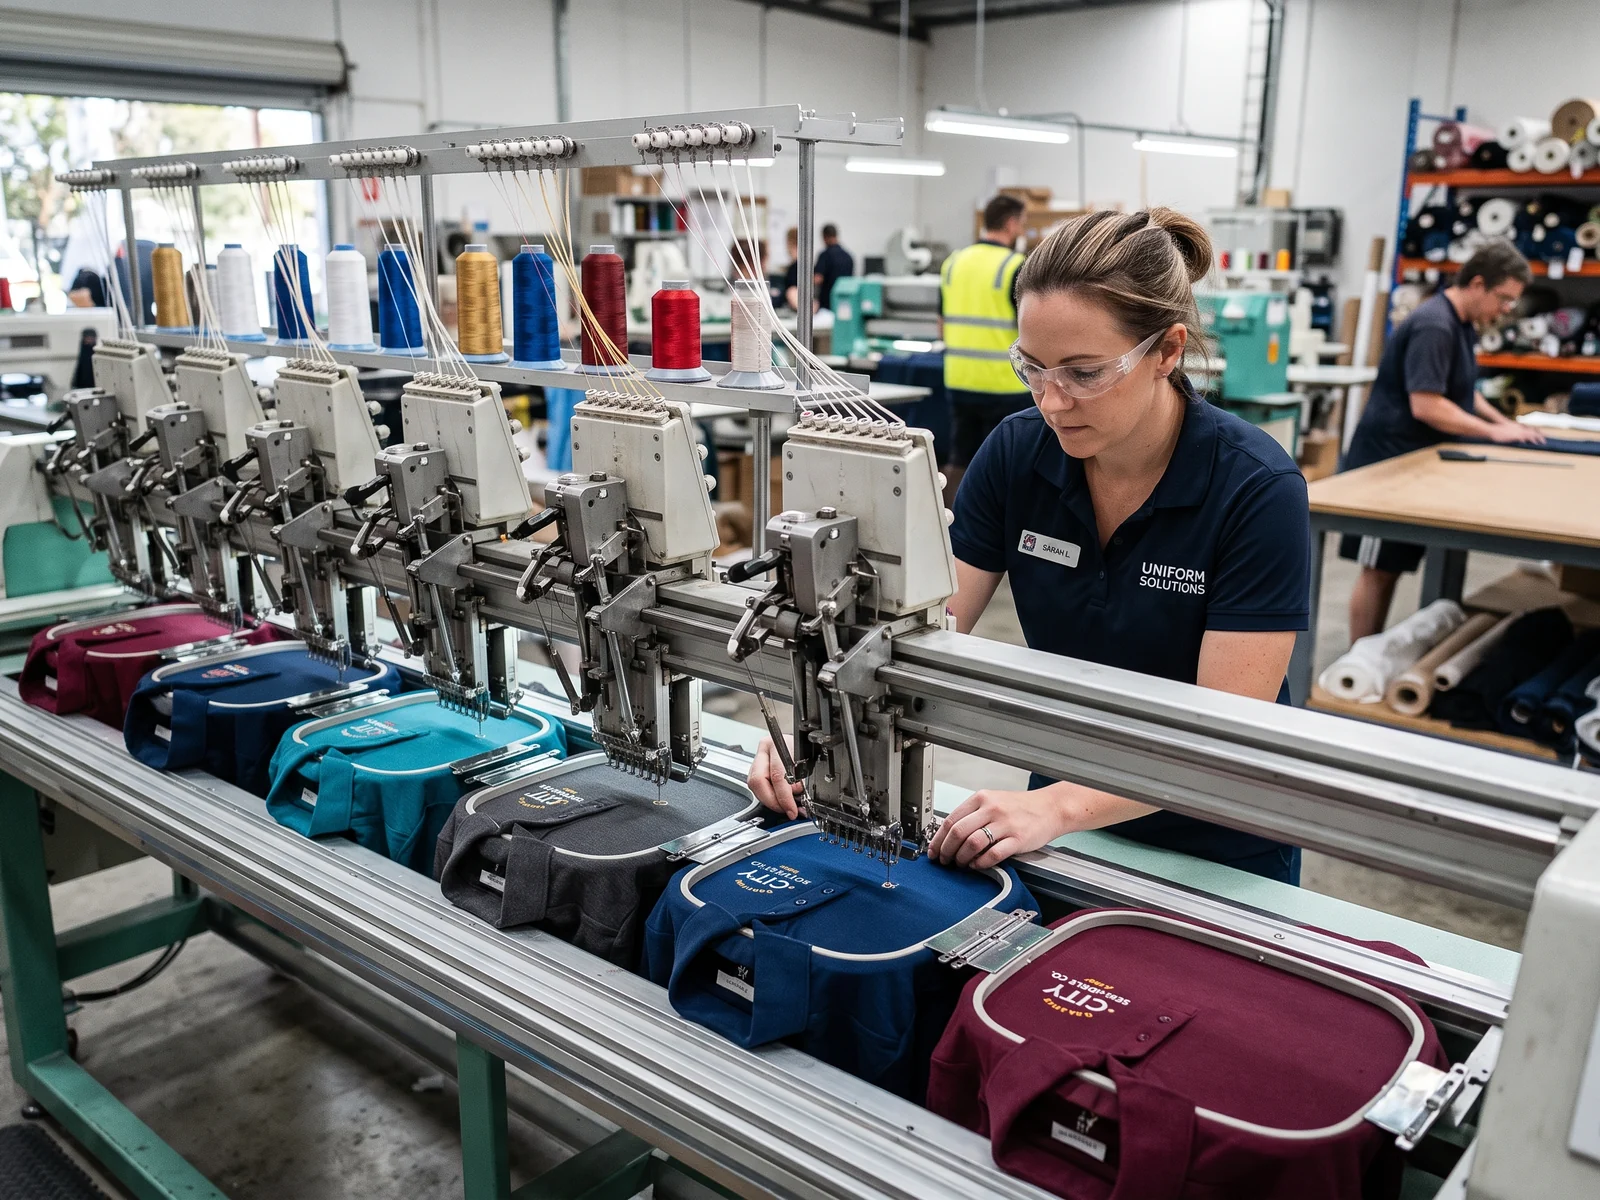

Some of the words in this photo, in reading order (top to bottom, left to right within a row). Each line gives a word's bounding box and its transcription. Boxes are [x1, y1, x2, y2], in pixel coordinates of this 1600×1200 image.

[1042, 544, 1065, 556] SARAH
[1141, 561, 1205, 583] UNIFORM
[1139, 575, 1206, 595] SOLUTIONS
[737, 869, 790, 889] CITY
[1042, 983, 1109, 1012] CITY
